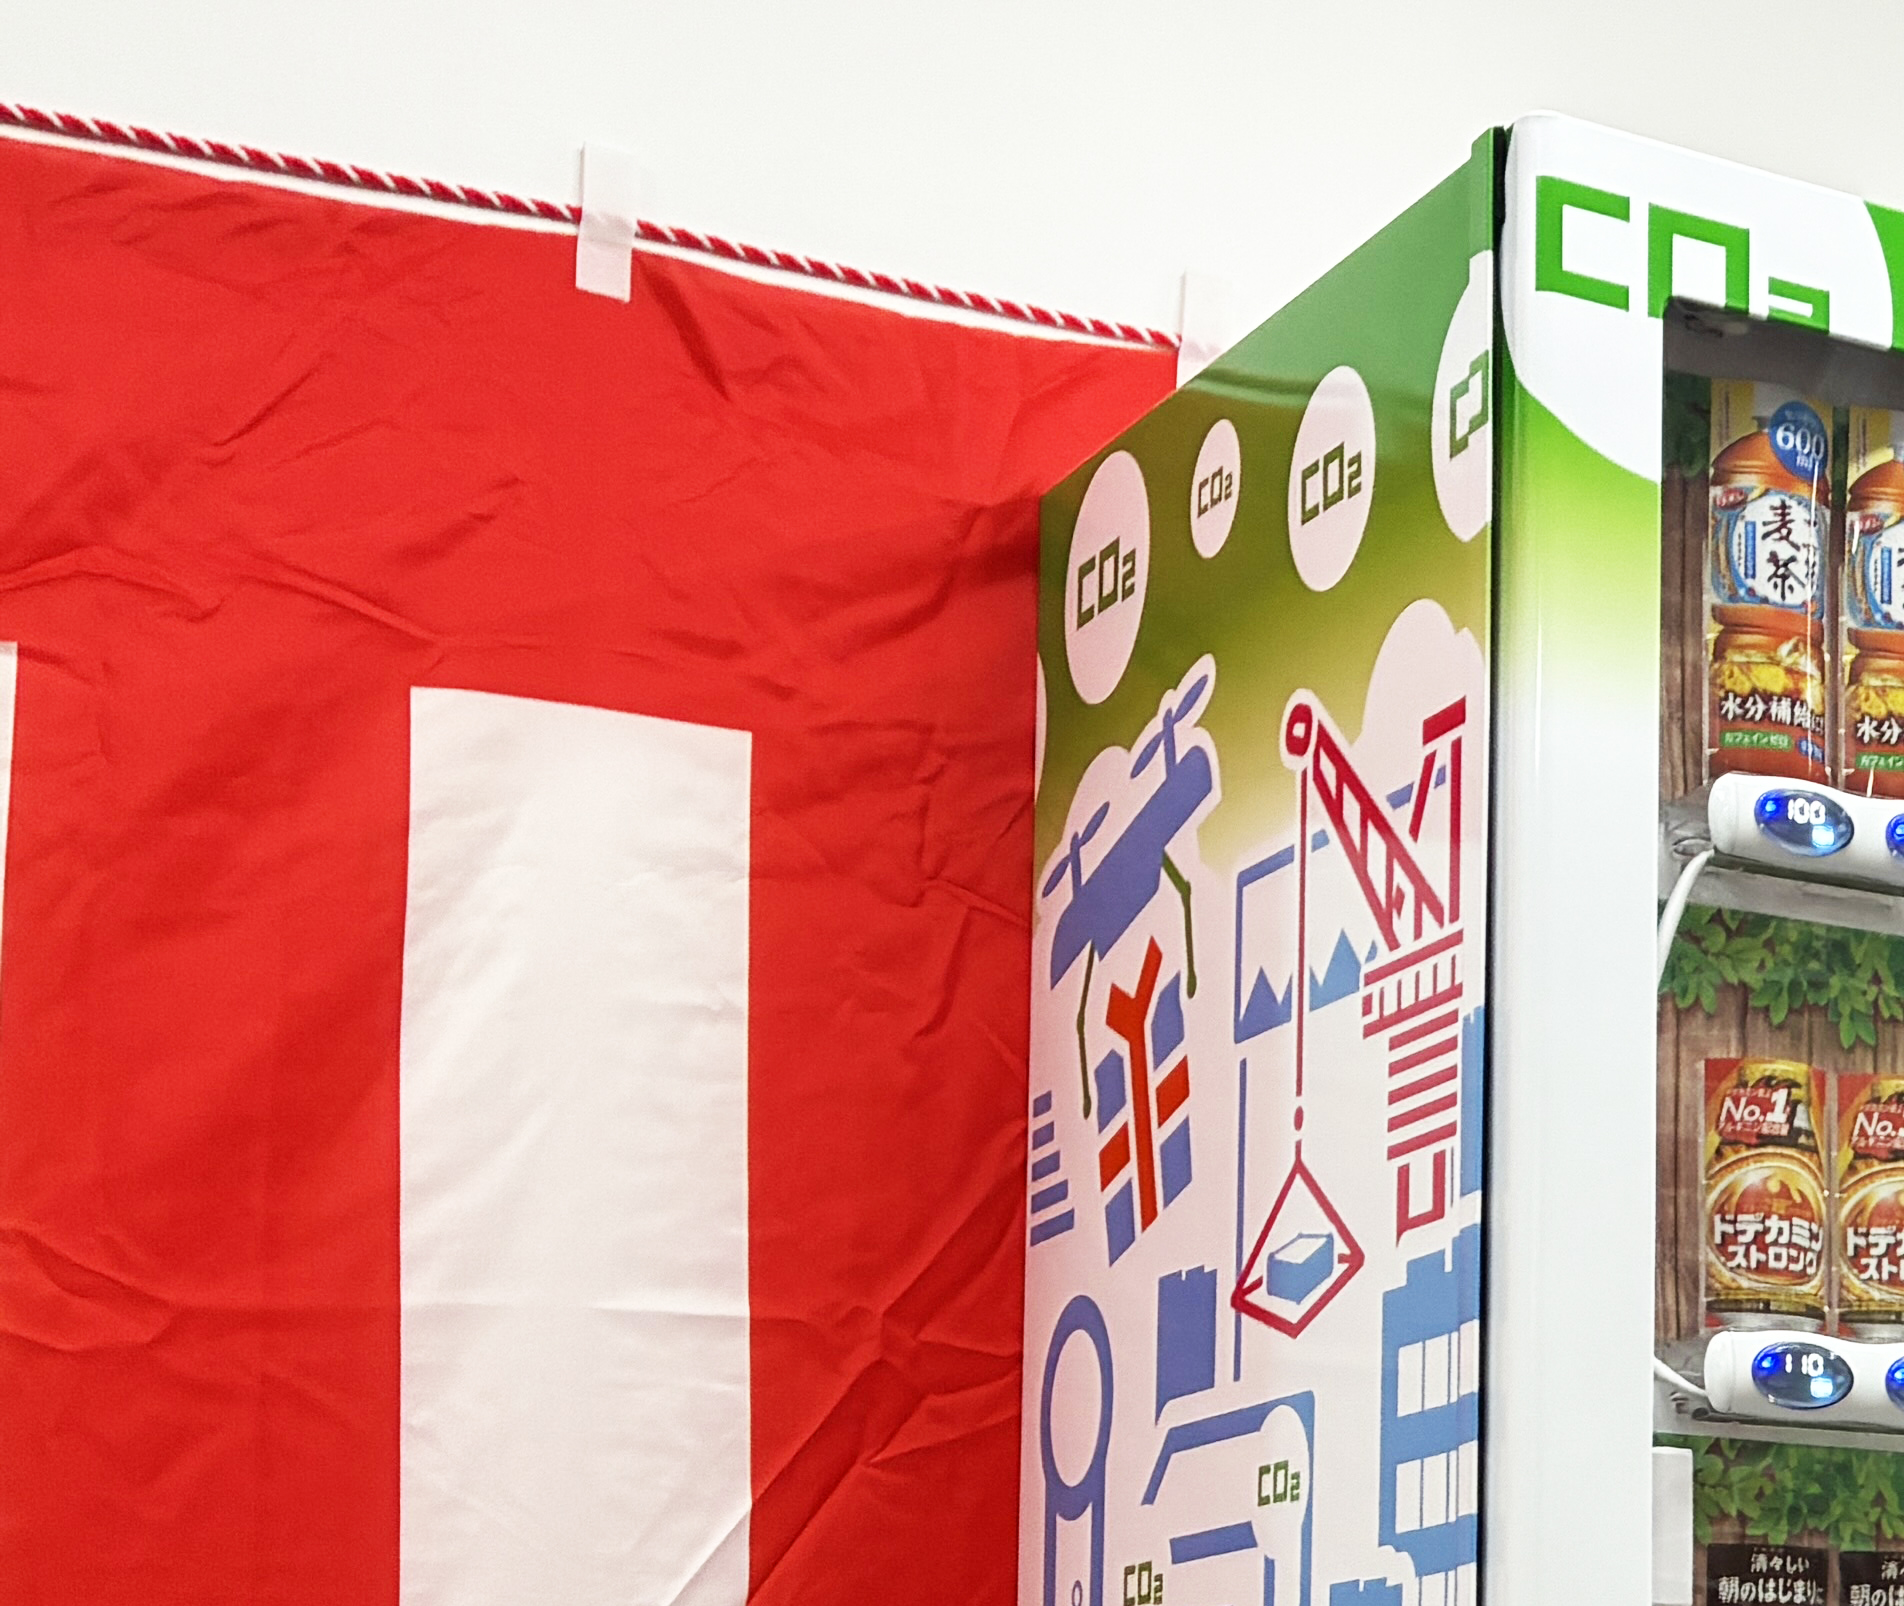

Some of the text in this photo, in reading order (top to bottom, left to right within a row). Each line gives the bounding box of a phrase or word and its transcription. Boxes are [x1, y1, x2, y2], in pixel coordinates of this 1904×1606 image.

[1776, 427, 1825, 461] 600
[1196, 465, 1234, 518] CO2
[1300, 440, 1363, 527] CO2
[1761, 499, 1804, 602] 麦茶
[1076, 535, 1137, 633] CO2
[1787, 798, 1826, 825] 100
[1719, 1088, 1789, 1125] No.1
[1713, 1213, 1823, 1250] ドデカミン
[1727, 1244, 1822, 1276] ストロング
[1784, 1352, 1824, 1377] 110
[1257, 1459, 1301, 1507] CO2
